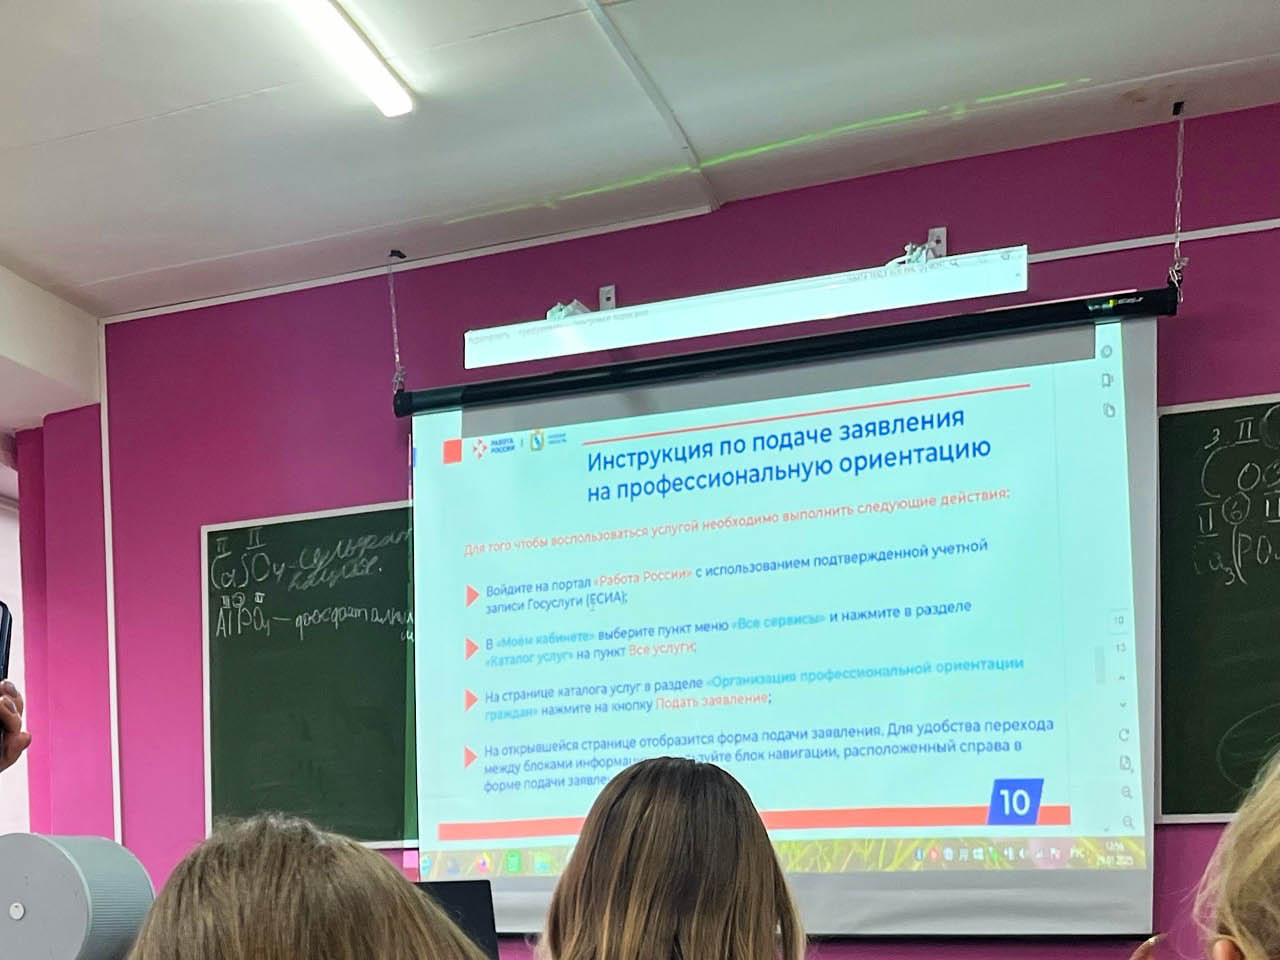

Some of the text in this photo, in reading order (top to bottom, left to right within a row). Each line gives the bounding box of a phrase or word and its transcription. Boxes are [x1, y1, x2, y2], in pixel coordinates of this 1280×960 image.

[588, 409, 964, 472] Инструкция по подаче заявления
[588, 439, 991, 502] на профессиональную ориентацию
[464, 487, 1010, 558] Для того чтобы воспользоваться услугой необходимо выполнить следующие действия:
[486, 538, 988, 598] Войдите на портал «Работа России» с использованием подтвержденной учетной
[486, 602, 524, 615] записи
[527, 595, 583, 612] Госуслуги
[486, 638, 493, 650] В
[598, 627, 655, 642] выберите
[658, 623, 692, 638] пункт
[695, 621, 729, 634] меню
[830, 612, 838, 623] и
[841, 607, 900, 622] нажмите
[904, 606, 912, 617] в
[915, 600, 971, 618] разделе
[576, 650, 590, 660] на
[593, 647, 625, 660] пункт
[628, 644, 649, 656] Все
[653, 641, 696, 656] услуги;
[485, 692, 499, 704] На
[502, 688, 554, 703] странице
[557, 684, 607, 698] каталога
[609, 682, 641, 697] услуг
[644, 682, 651, 692] в
[654, 678, 703, 695] разделе
[800, 661, 932, 685] профессиональной
[936, 657, 1024, 676] ориентации
[542, 704, 591, 717] нажмите
[594, 702, 608, 713] на
[611, 699, 653, 714] кнопку
[656, 696, 698, 710] Подать
[702, 693, 772, 708] заявление;
[484, 716, 1054, 758] На открывшейся странице отобразится форма подачи заявления. Для удобства перехода
[484, 762, 521, 776] между
[523, 756, 572, 772] блоками
[735, 748, 765, 762] блок
[768, 744, 840, 761] навигации,
[843, 738, 956, 758] расположенный
[959, 739, 1011, 756] справа
[1015, 740, 1022, 751] в
[483, 778, 521, 793] форме
[524, 776, 565, 791] подачи
[1000, 789, 1030, 816] 10
